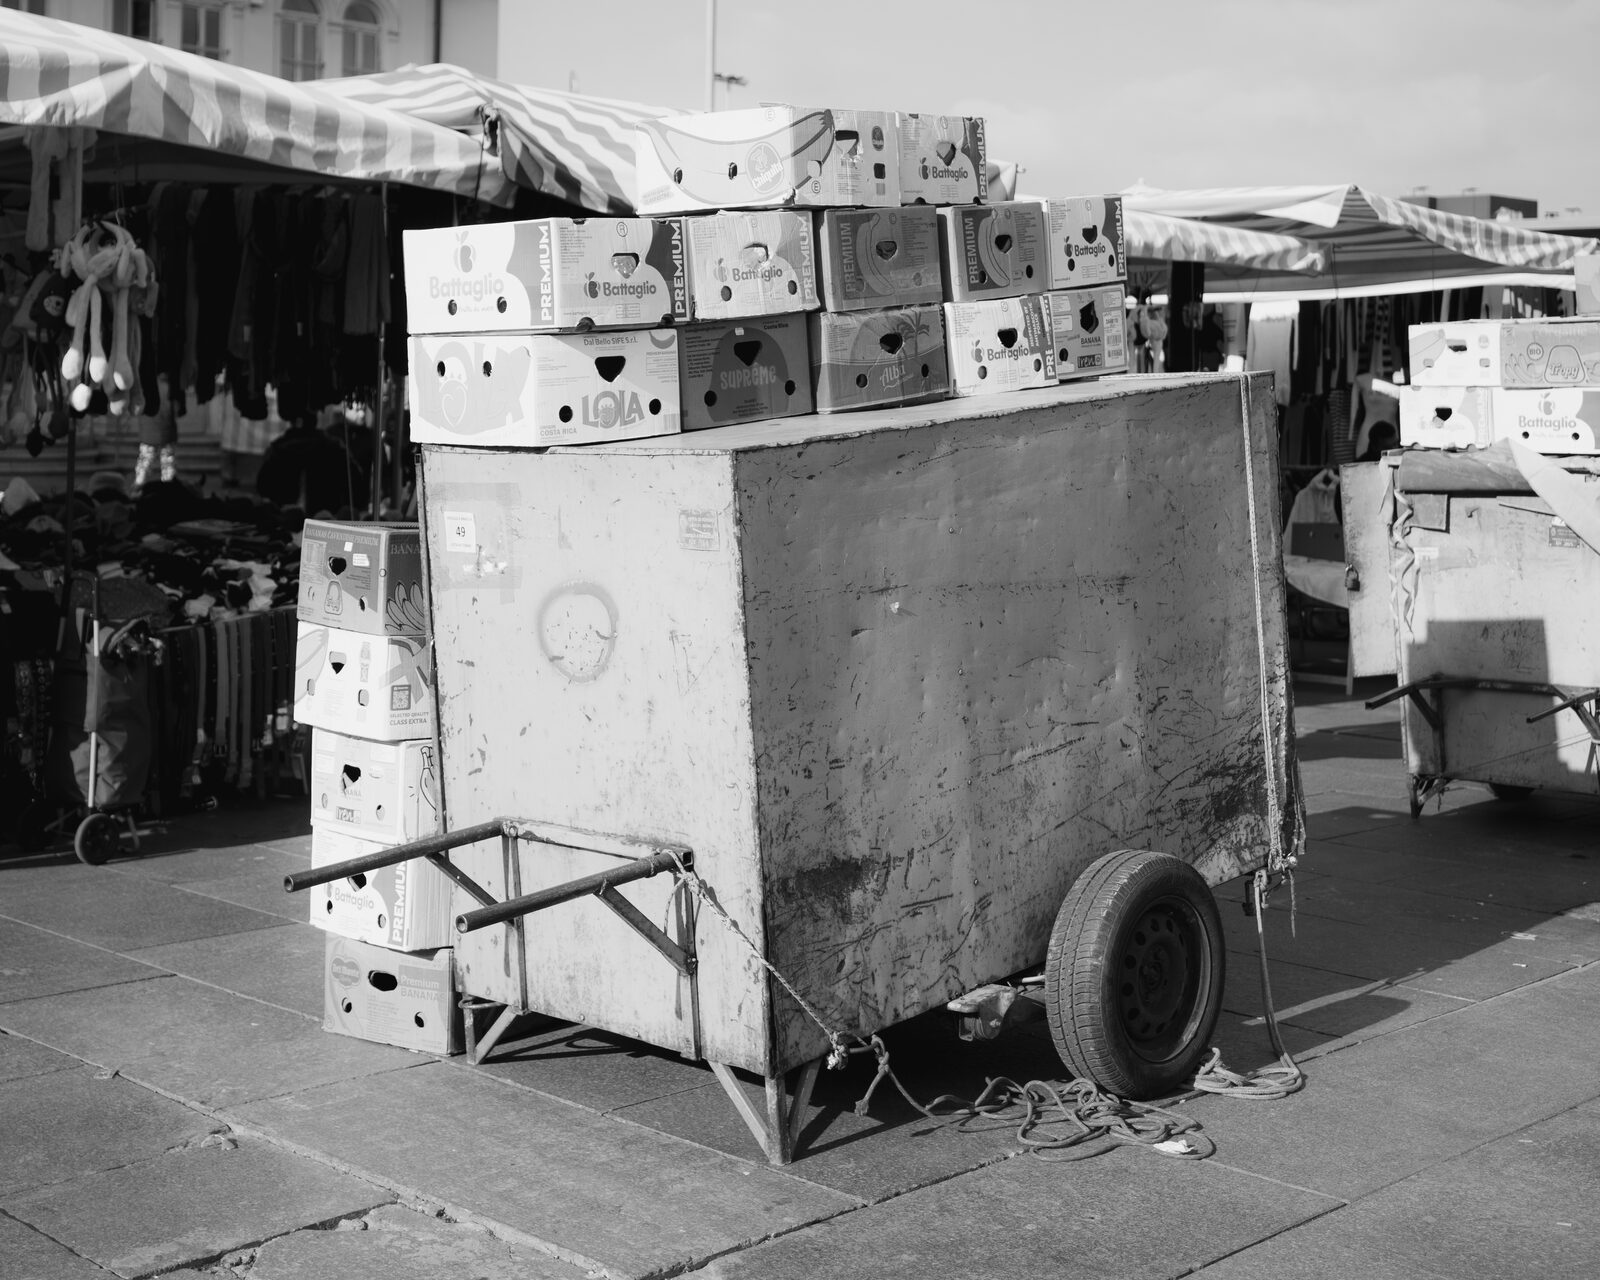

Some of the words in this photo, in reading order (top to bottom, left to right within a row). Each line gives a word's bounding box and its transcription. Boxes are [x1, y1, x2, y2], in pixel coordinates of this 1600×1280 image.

[975, 118, 987, 196] PREMIUM
[932, 166, 968, 182] Battaglio
[1114, 201, 1125, 273] PREMIUM
[799, 216, 813, 299] PREMIUM
[840, 222, 857, 293] PREMIUM
[964, 217, 979, 284] PREMIUM
[1074, 242, 1106, 258] Battaglio
[538, 224, 552, 321] PREMIUM
[671, 222, 686, 314] PREMIUM
[429, 272, 504, 302] Battaglio
[602, 281, 657, 299] Battaglio
[1080, 336, 1102, 345] BANANA
[987, 345, 1029, 360] Battaglio
[581, 390, 645, 429] LOLA
[540, 429, 561, 437] COSTA
[1518, 415, 1577, 432] Battaglio
[456, 526, 465, 537] 49
[390, 543, 420, 555] BANA
[334, 886, 375, 911] Battaglio
[400, 975, 440, 989] Premium
